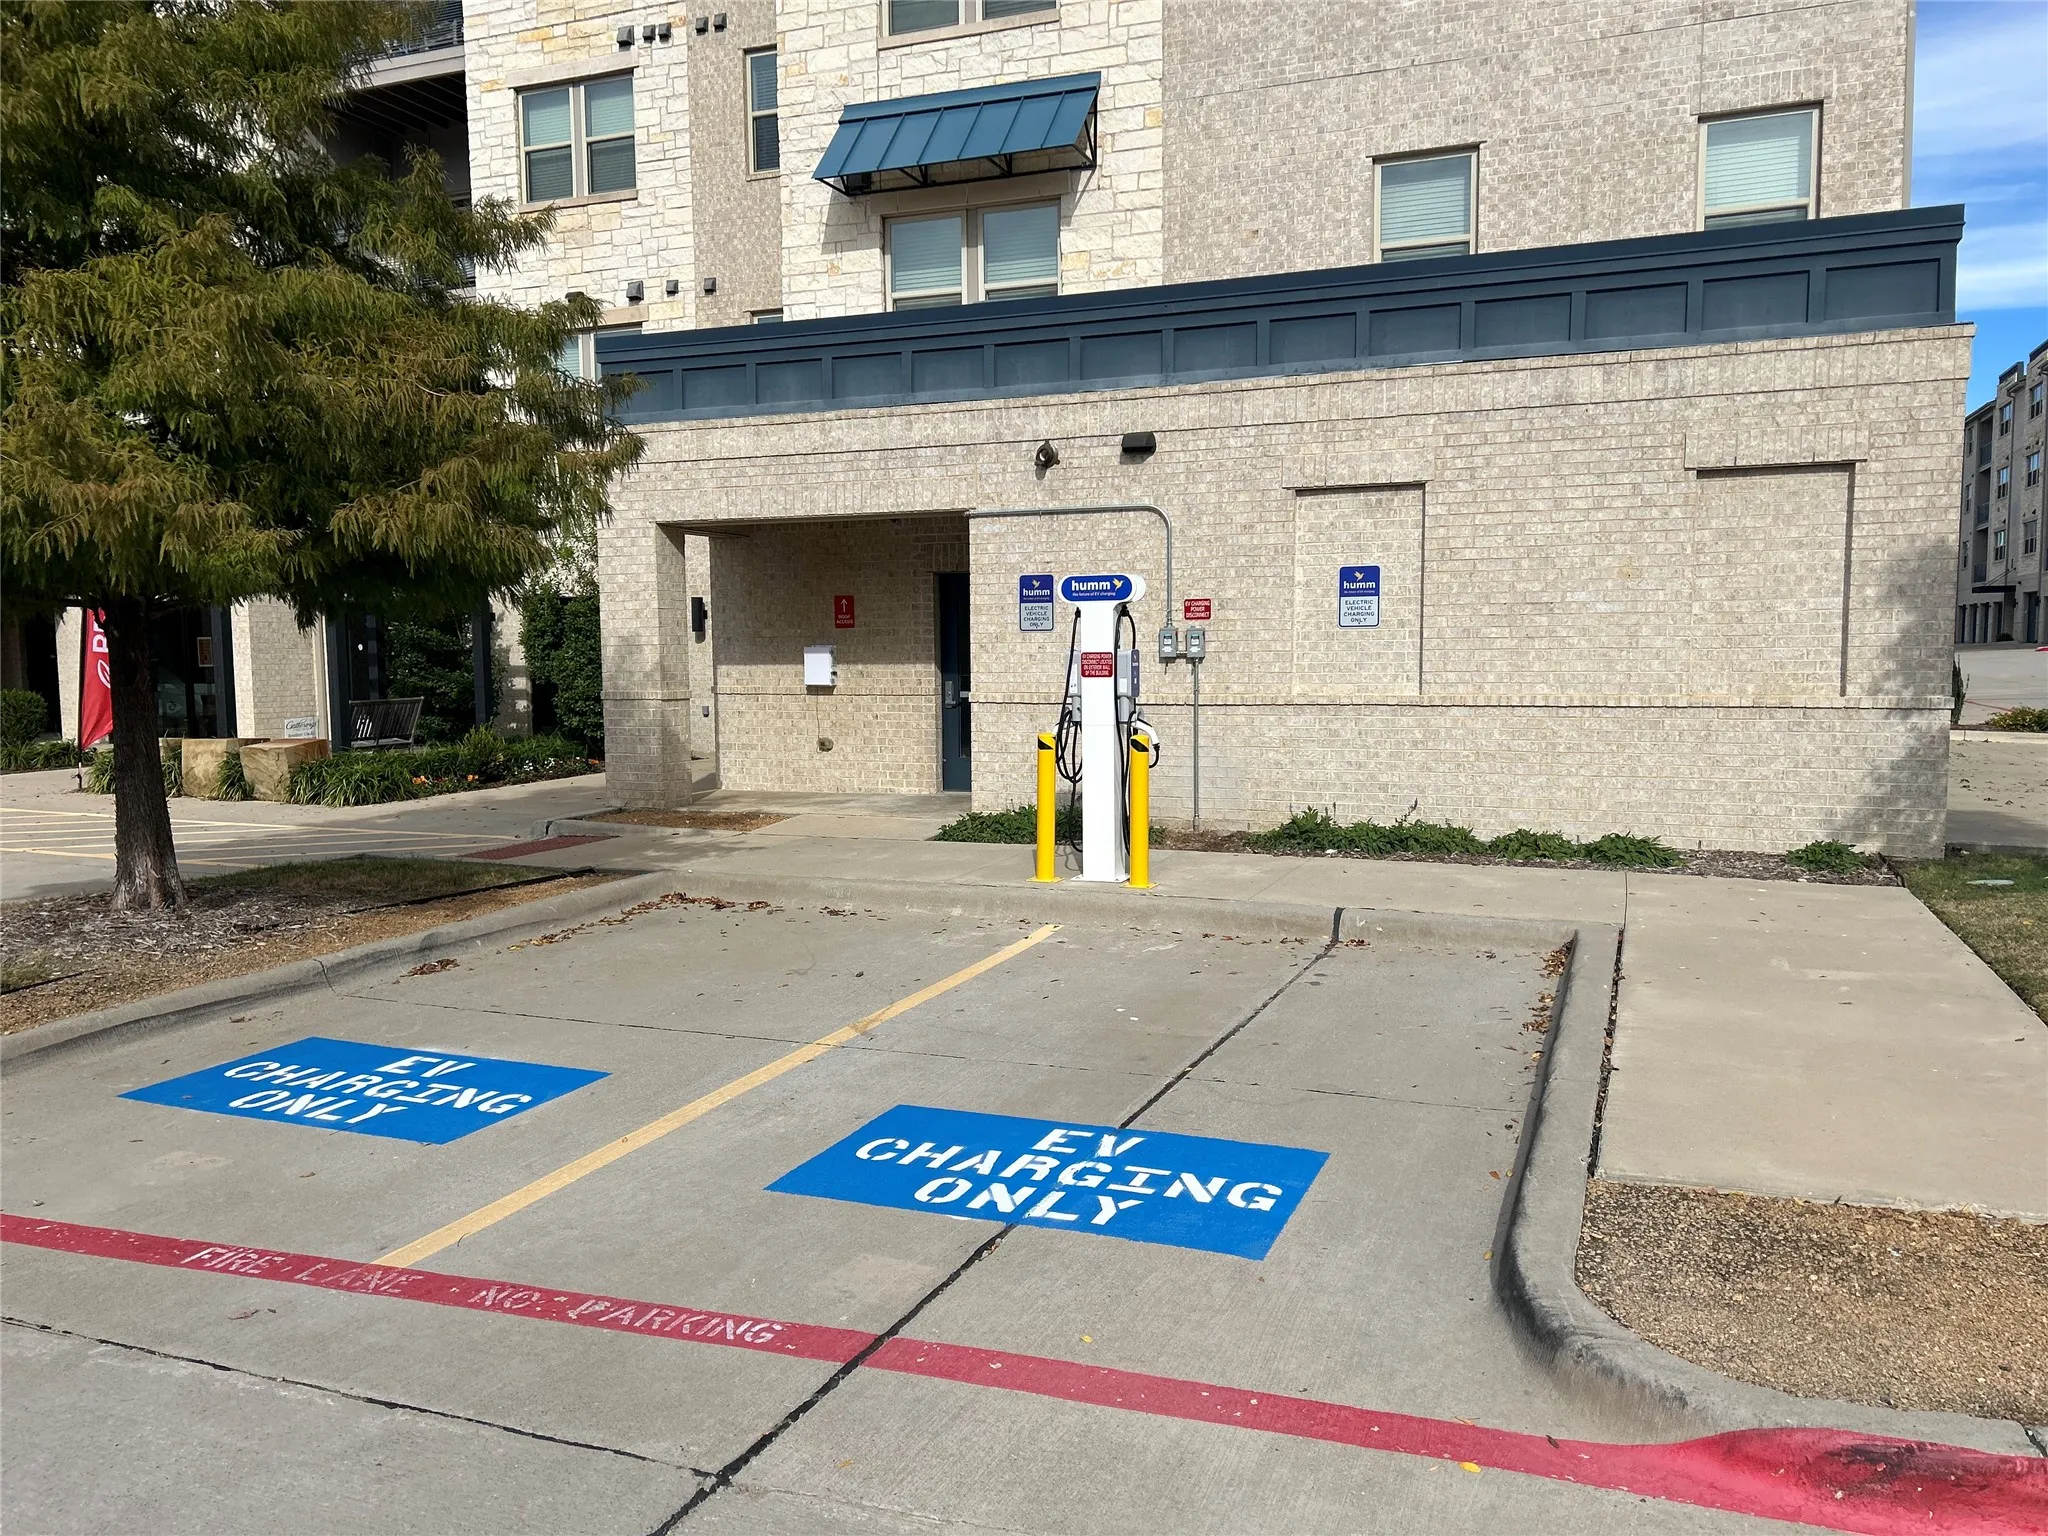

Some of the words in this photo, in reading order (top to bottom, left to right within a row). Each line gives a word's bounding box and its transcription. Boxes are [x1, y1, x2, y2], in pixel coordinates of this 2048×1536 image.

[1023, 588, 1050, 596] humm
[1071, 580, 1111, 591] humm
[1344, 580, 1376, 589] humm
[376, 1055, 476, 1077] EV
[223, 1060, 533, 1115] CHARGING
[228, 1089, 409, 1124] ONLY
[1031, 1127, 1145, 1158] EV
[854, 1137, 1283, 1212] CHARGING
[913, 1176, 1145, 1226] ONLY
[179, 1246, 286, 1274] FIRE
[295, 1262, 424, 1294] LANE
[467, 1285, 542, 1309] NO
[568, 1299, 784, 1344] PARKING
